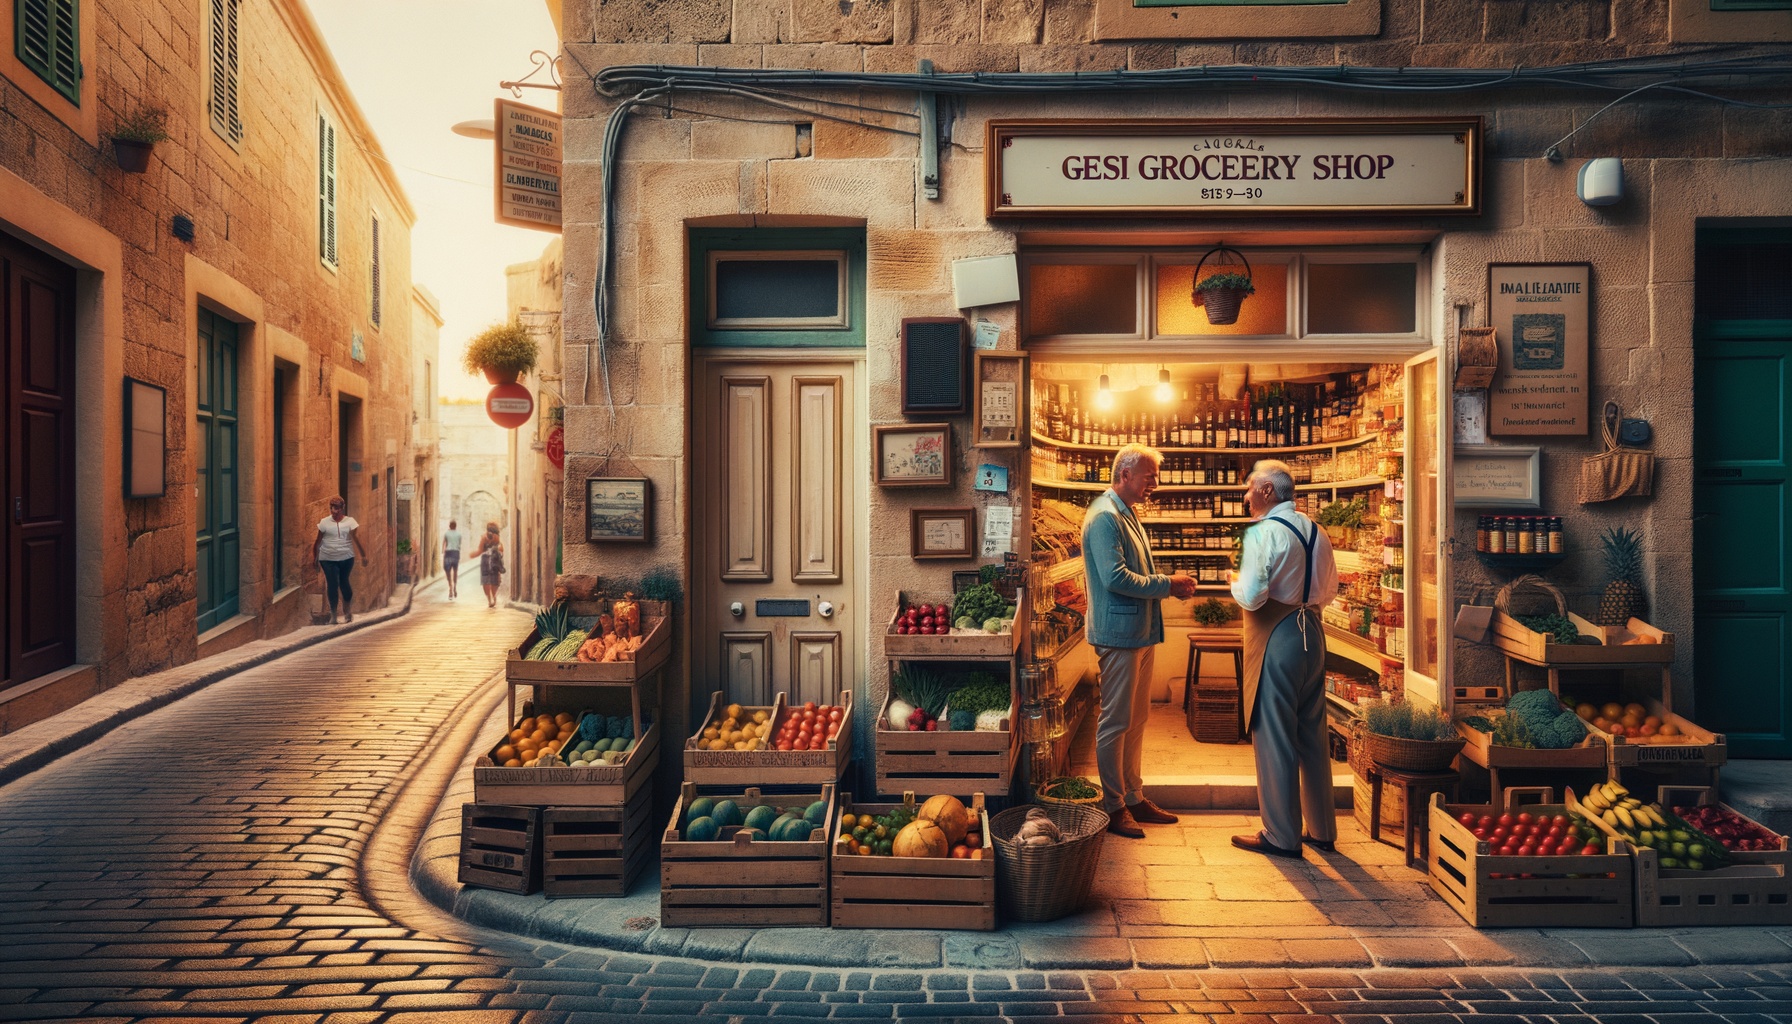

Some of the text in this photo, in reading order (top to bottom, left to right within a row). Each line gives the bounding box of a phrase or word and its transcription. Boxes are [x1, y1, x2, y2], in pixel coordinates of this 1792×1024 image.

[1062, 154, 1395, 181] GESI GROCEERY SHOP
